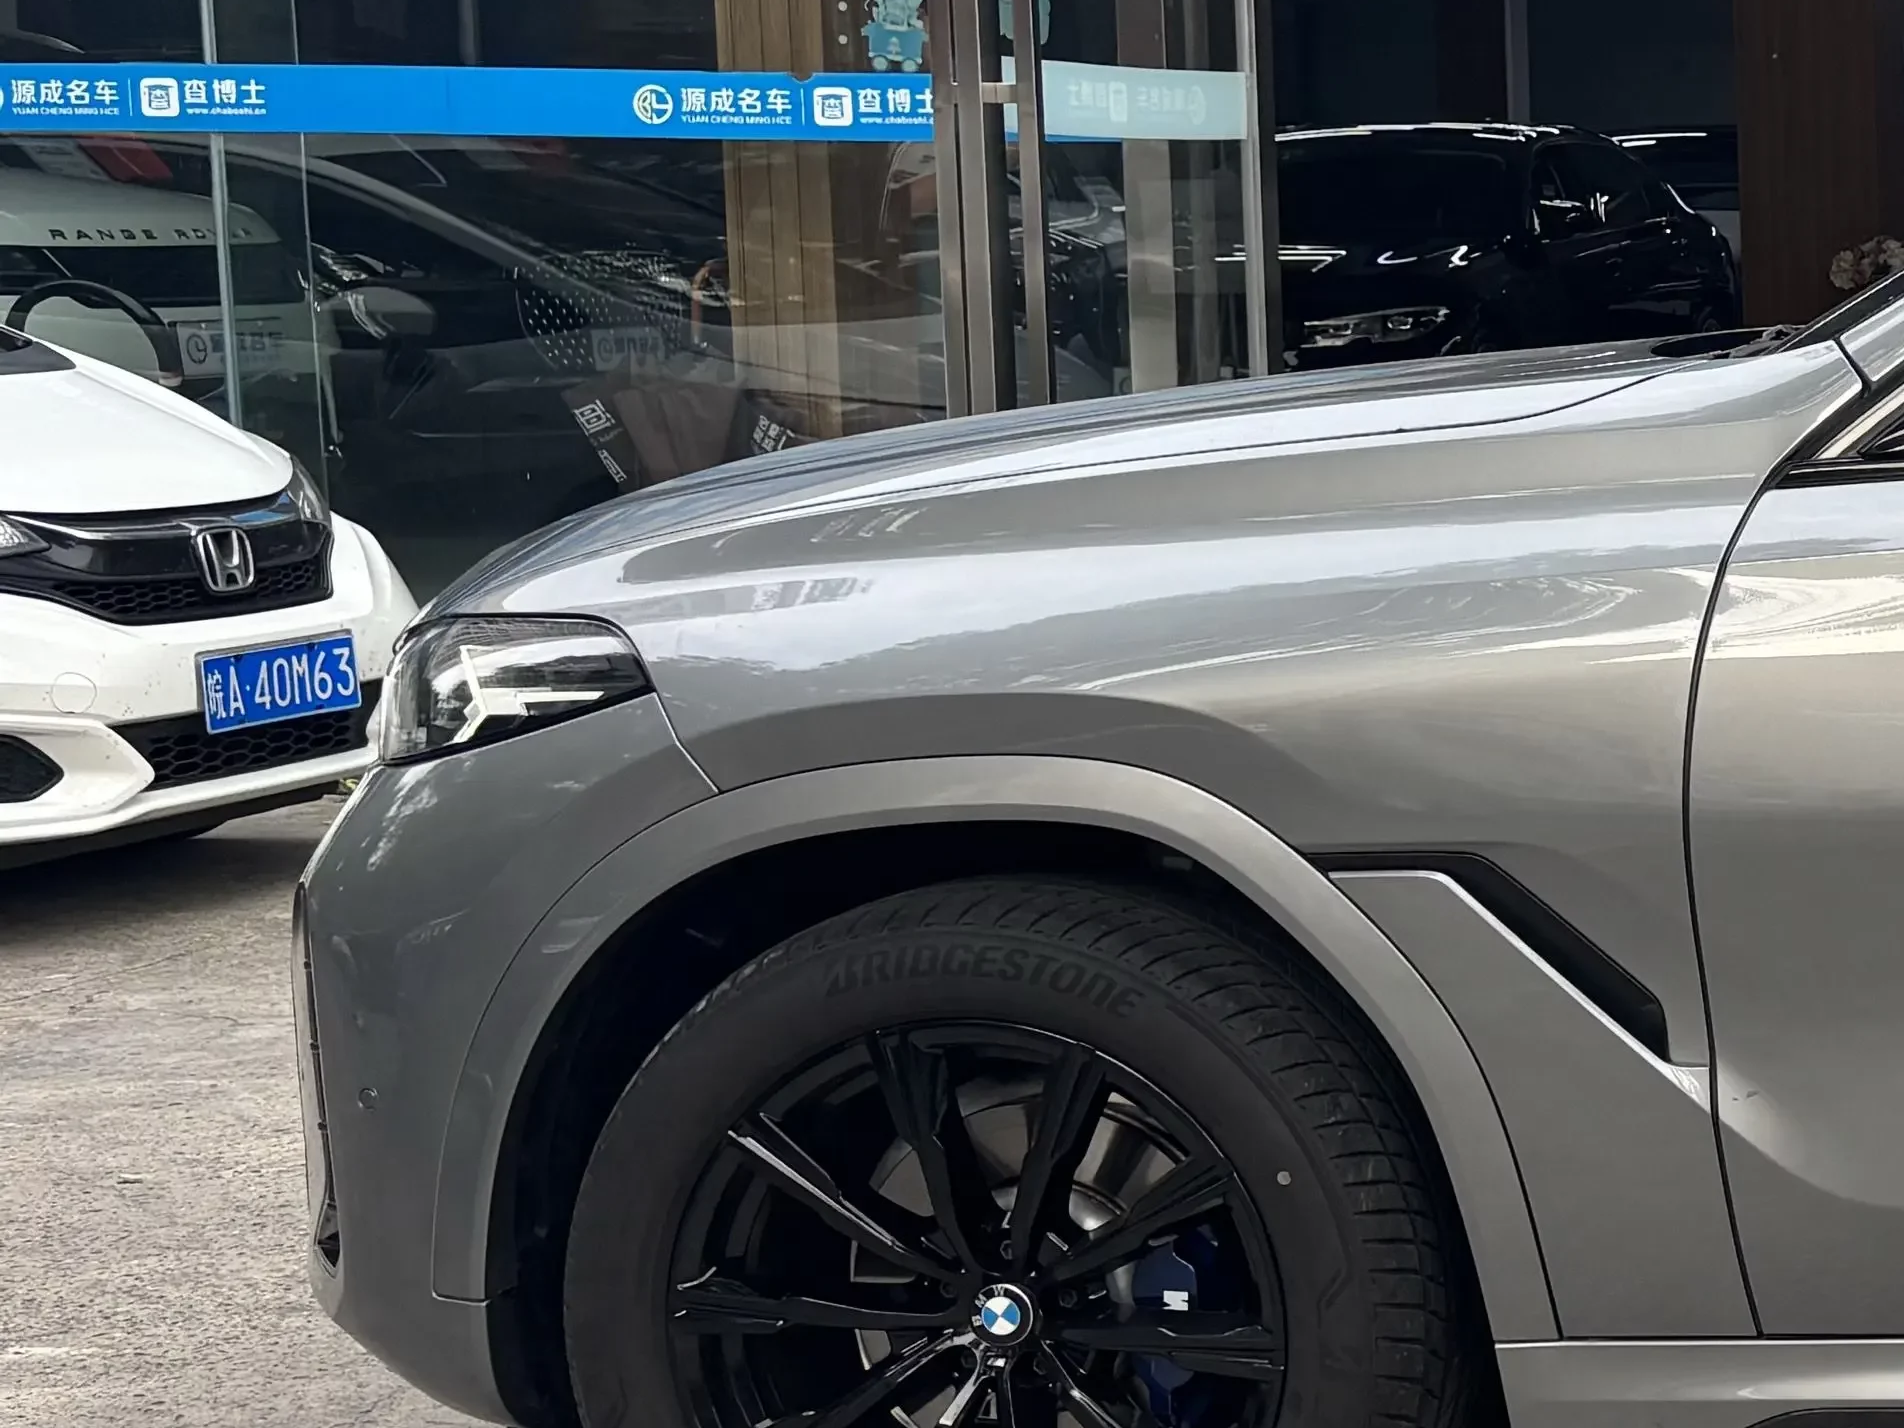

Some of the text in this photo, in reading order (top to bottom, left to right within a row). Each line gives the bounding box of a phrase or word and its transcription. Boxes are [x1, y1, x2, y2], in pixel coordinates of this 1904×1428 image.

[10, 78, 121, 105] 源成名车
[182, 78, 266, 104] 查博士
[680, 87, 793, 114] 源成名车
[856, 87, 934, 114] 查博士
[825, 942, 1147, 1019] BRIDGESTONE
